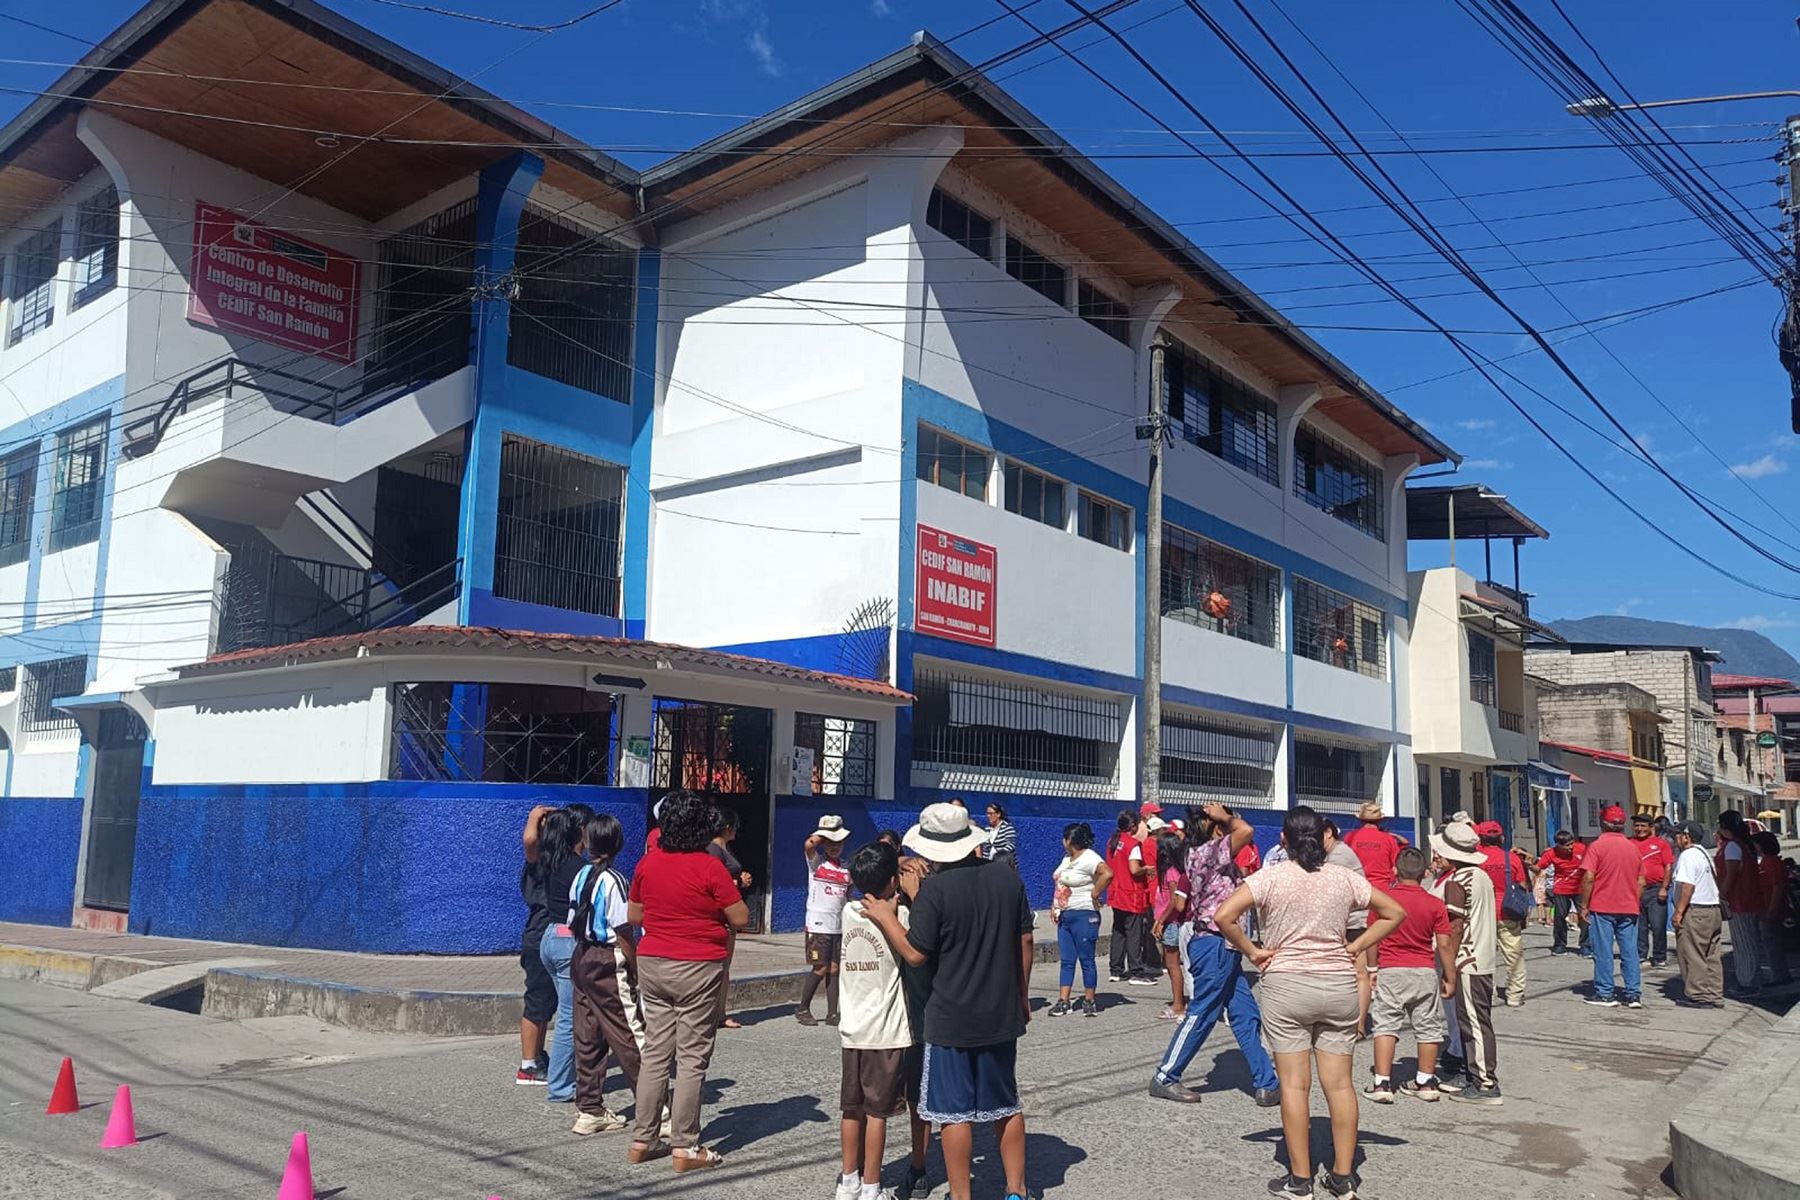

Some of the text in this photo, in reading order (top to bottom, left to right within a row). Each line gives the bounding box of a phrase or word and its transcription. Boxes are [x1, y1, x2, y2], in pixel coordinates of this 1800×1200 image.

[208, 245, 254, 272] Centro
[257, 260, 275, 278] de
[277, 265, 343, 301] Desarrollo
[207, 265, 344, 323] Integral de la Familia
[218, 292, 330, 340] CEDIF San Ramón
[922, 549, 991, 583] CEDIF SAN RAMÓN
[927, 577, 985, 612] INABIF
[845, 961, 858, 972] SAN
